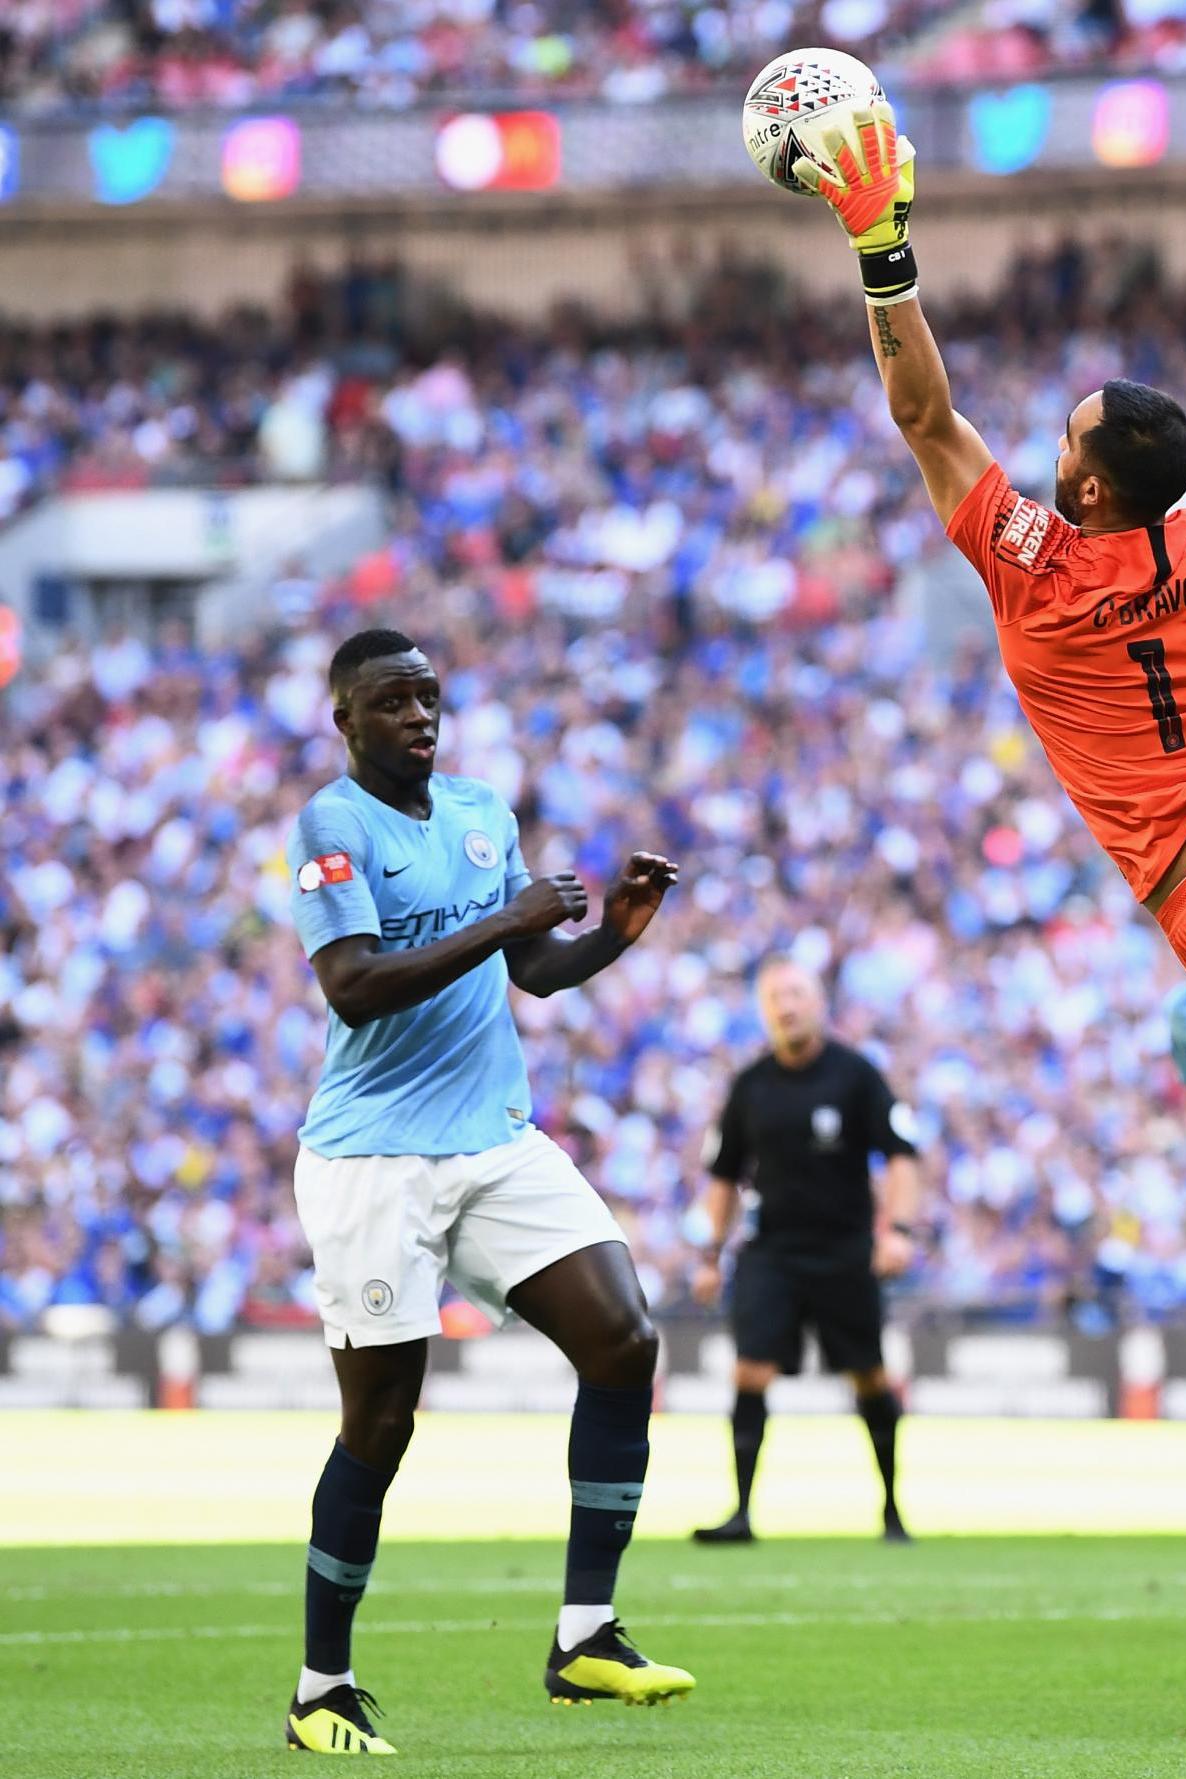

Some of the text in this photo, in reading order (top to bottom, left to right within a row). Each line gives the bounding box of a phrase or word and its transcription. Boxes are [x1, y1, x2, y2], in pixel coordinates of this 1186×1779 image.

[1005, 503, 1037, 548] TIRE
[1017, 505, 1050, 566] NEXEN
[1127, 637, 1186, 754] 1
